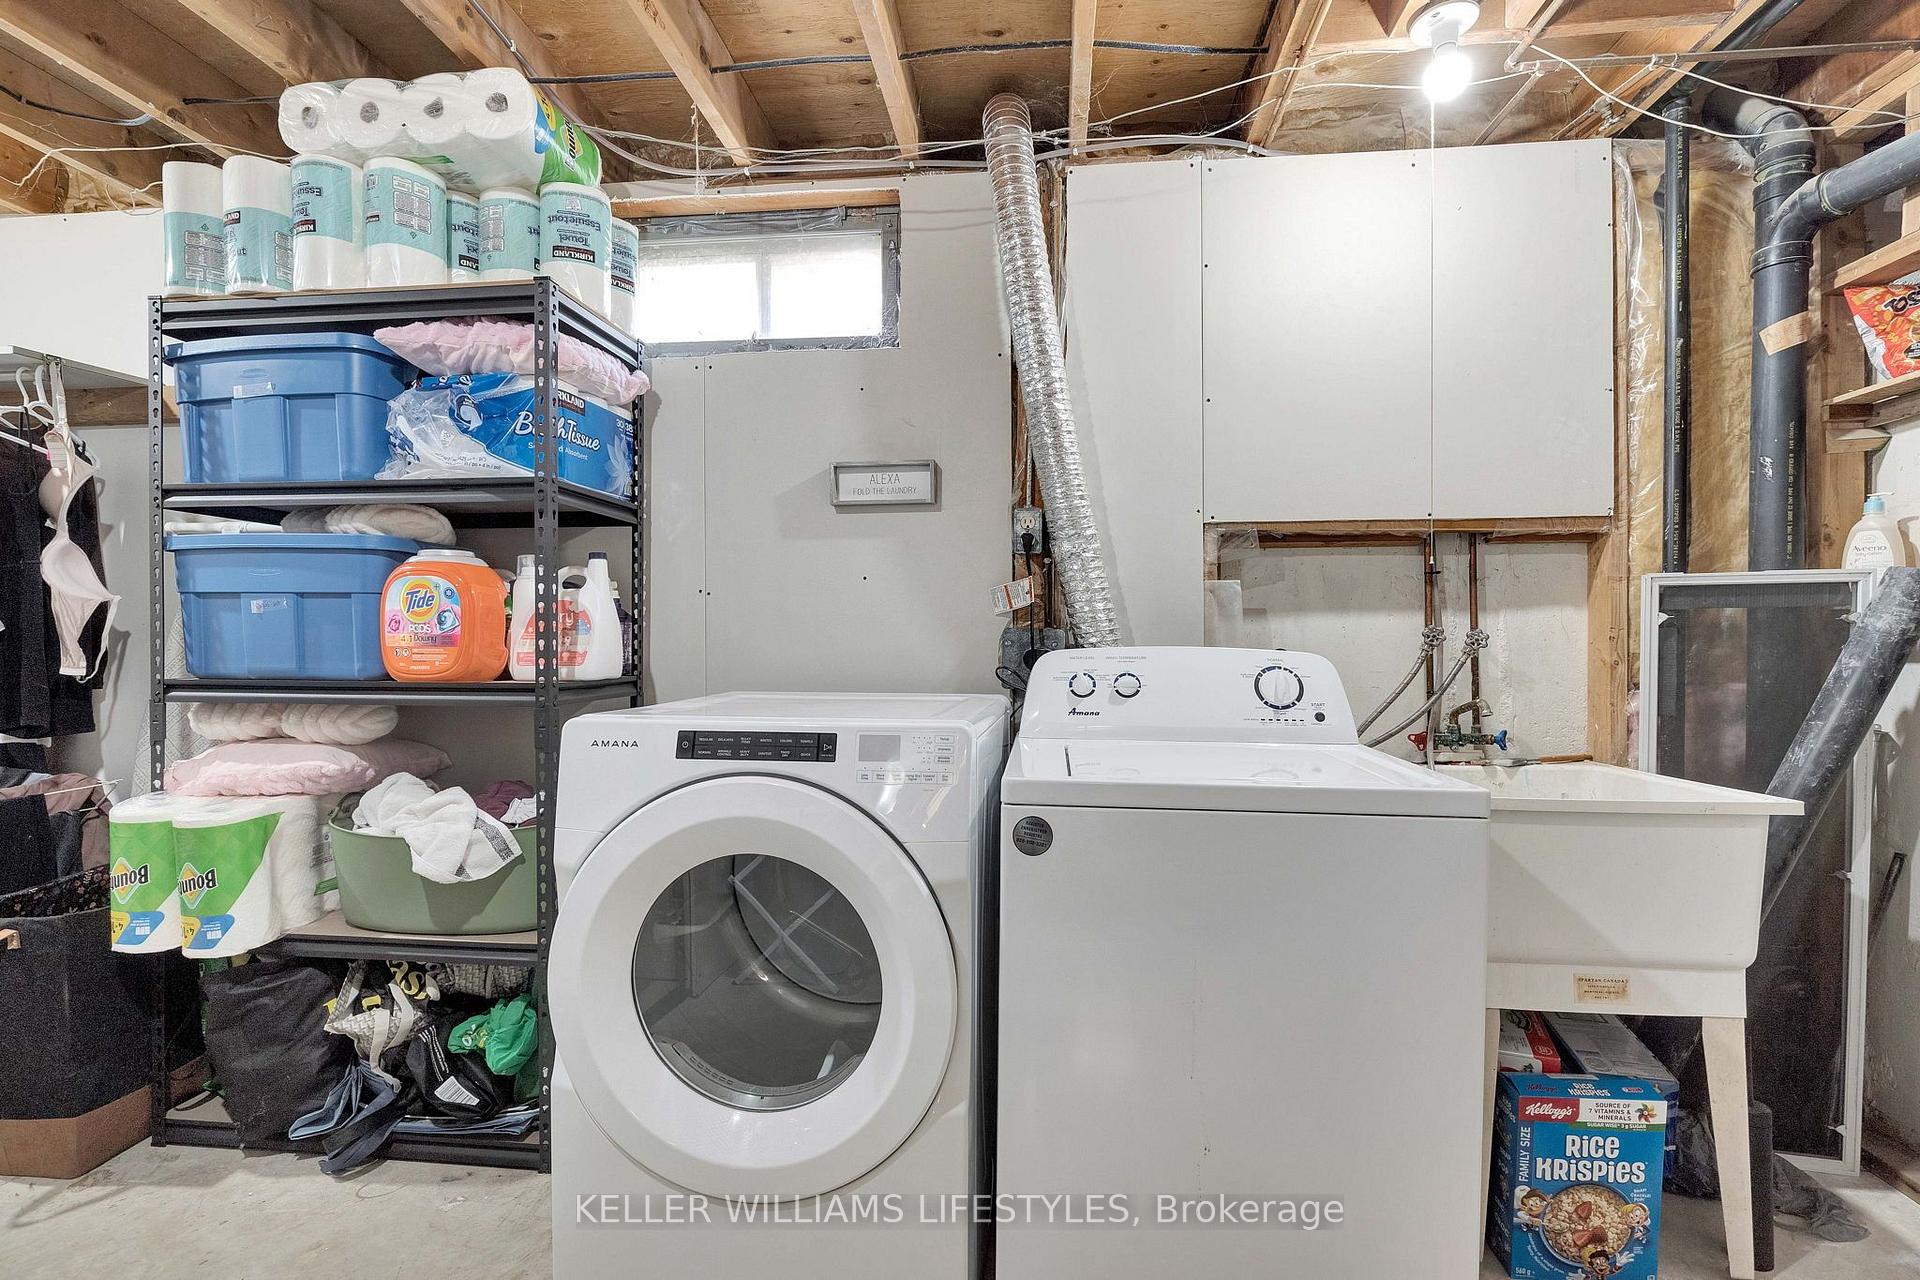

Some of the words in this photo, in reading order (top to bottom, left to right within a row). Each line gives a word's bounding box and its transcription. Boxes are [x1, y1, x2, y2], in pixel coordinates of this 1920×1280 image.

[559, 234, 590, 247] Towel
[553, 249, 594, 262] KIRKLAND
[567, 419, 600, 451] Tissue
[869, 473, 901, 485] ALEXA
[852, 487, 870, 496] FOLD
[873, 487, 885, 495] THE
[886, 486, 917, 495] LAUNDRY
[405, 590, 435, 613] Tide
[1068, 707, 1100, 717] Amana
[590, 740, 639, 748] AMANA
[1525, 1103, 1574, 1120] Kellogg's
[1520, 1126, 1531, 1147] SIZE
[1518, 1150, 1530, 1182] FAMILY
